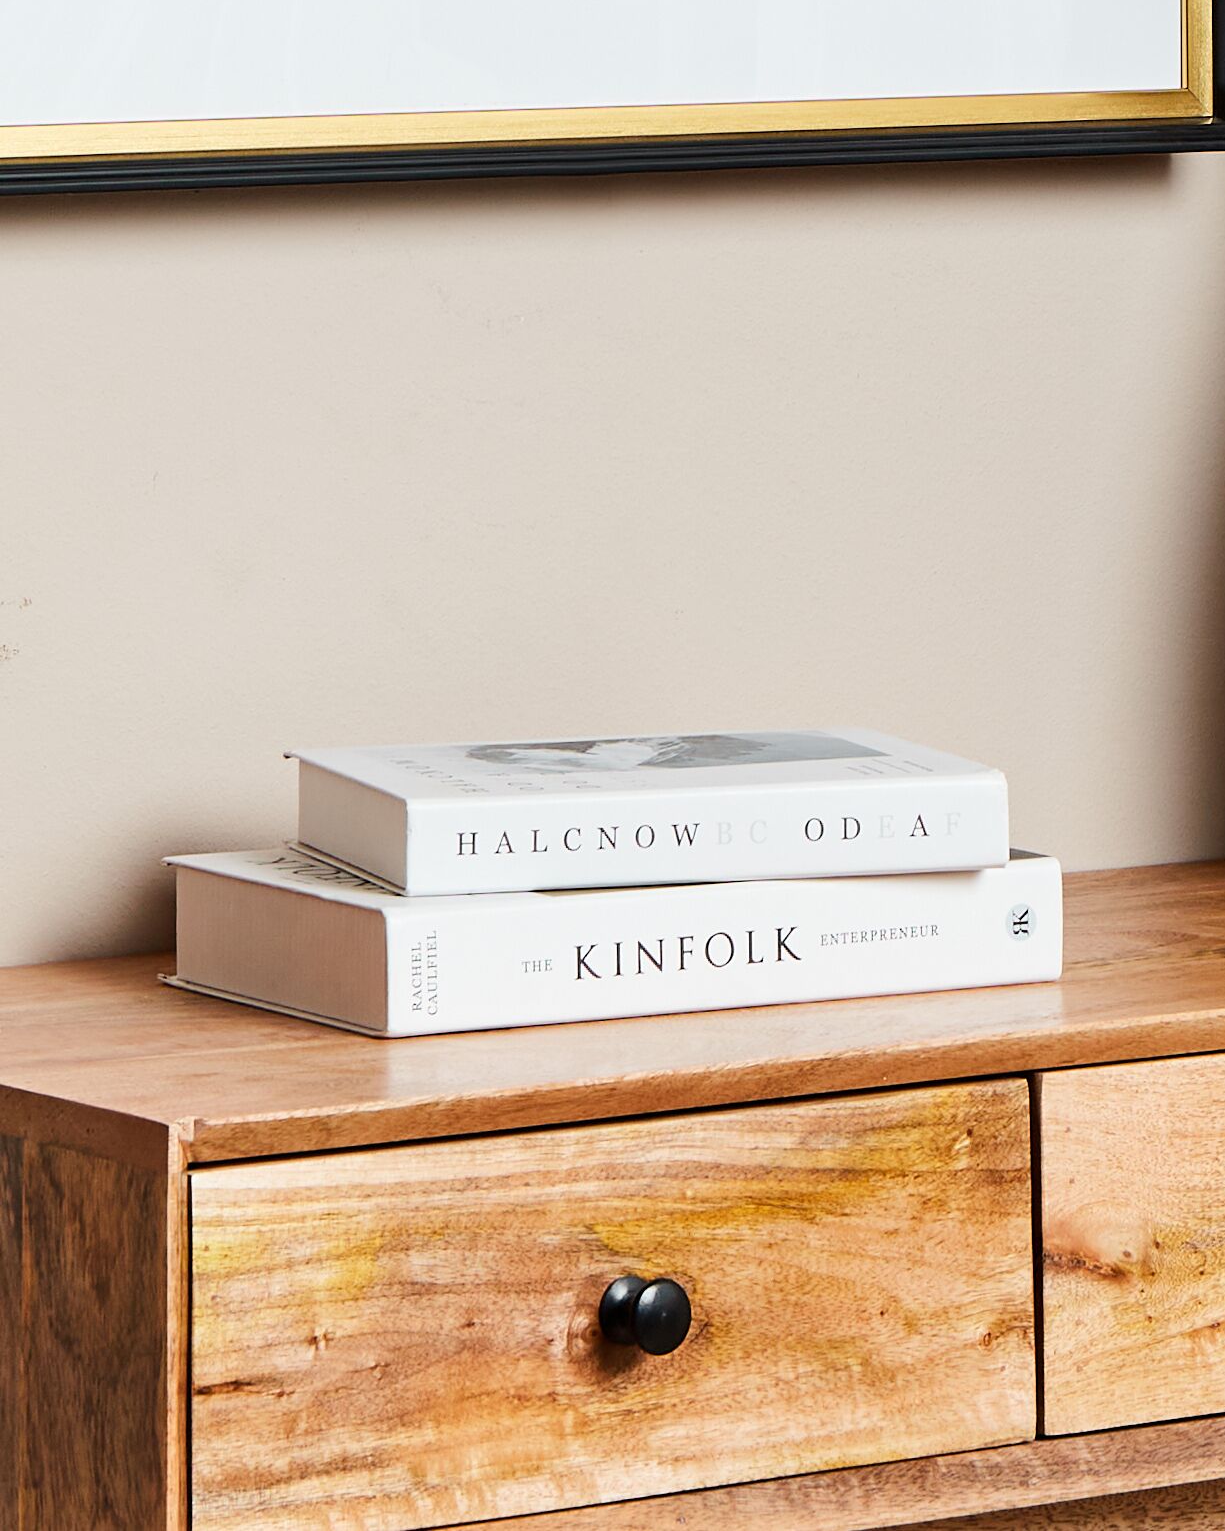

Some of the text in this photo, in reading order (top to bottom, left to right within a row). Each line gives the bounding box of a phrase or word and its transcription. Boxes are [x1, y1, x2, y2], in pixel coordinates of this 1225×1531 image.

[410, 941, 422, 1012] RACHEL
[521, 924, 940, 981] THE KINFOLK ENTERPRENEUR
